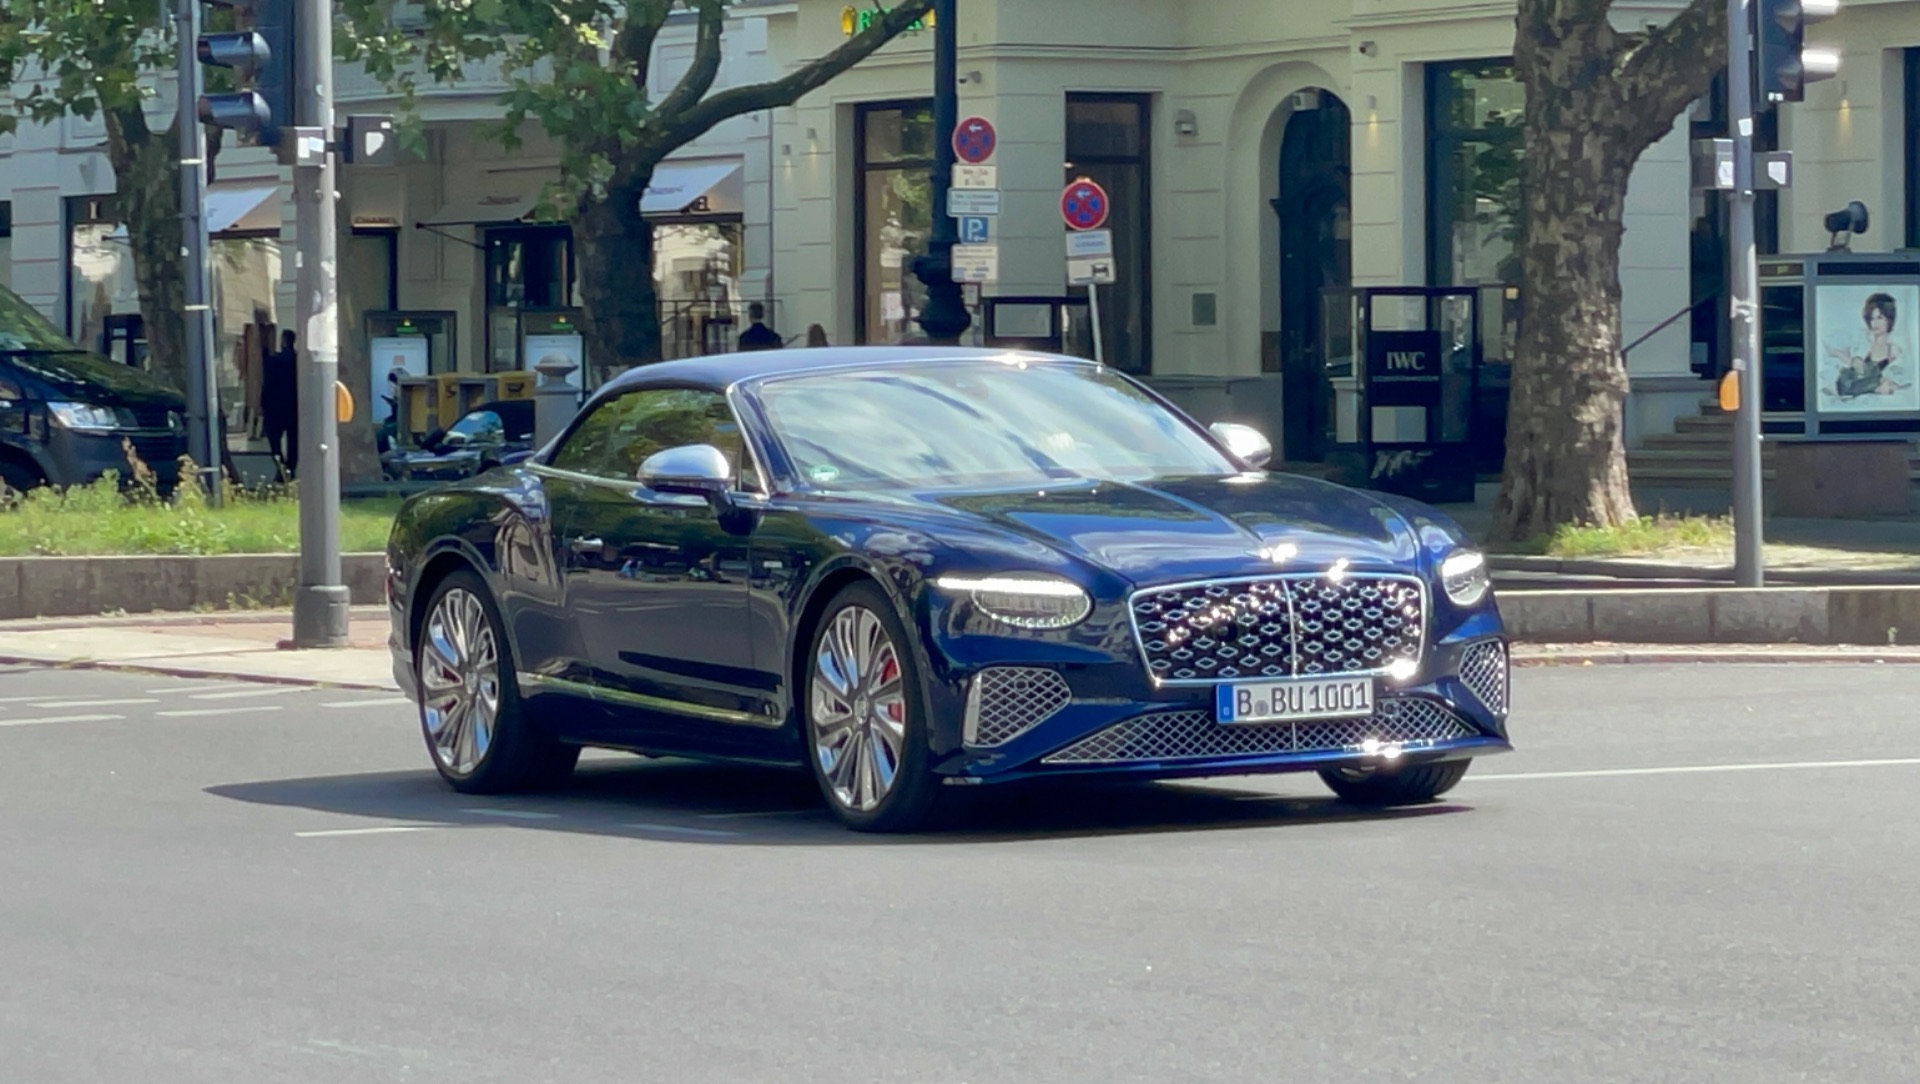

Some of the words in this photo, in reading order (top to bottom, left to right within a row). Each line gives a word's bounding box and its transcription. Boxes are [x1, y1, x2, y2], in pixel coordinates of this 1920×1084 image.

[967, 218, 983, 240] P
[1386, 351, 1425, 371] IWC
[1237, 689, 1252, 716] B
